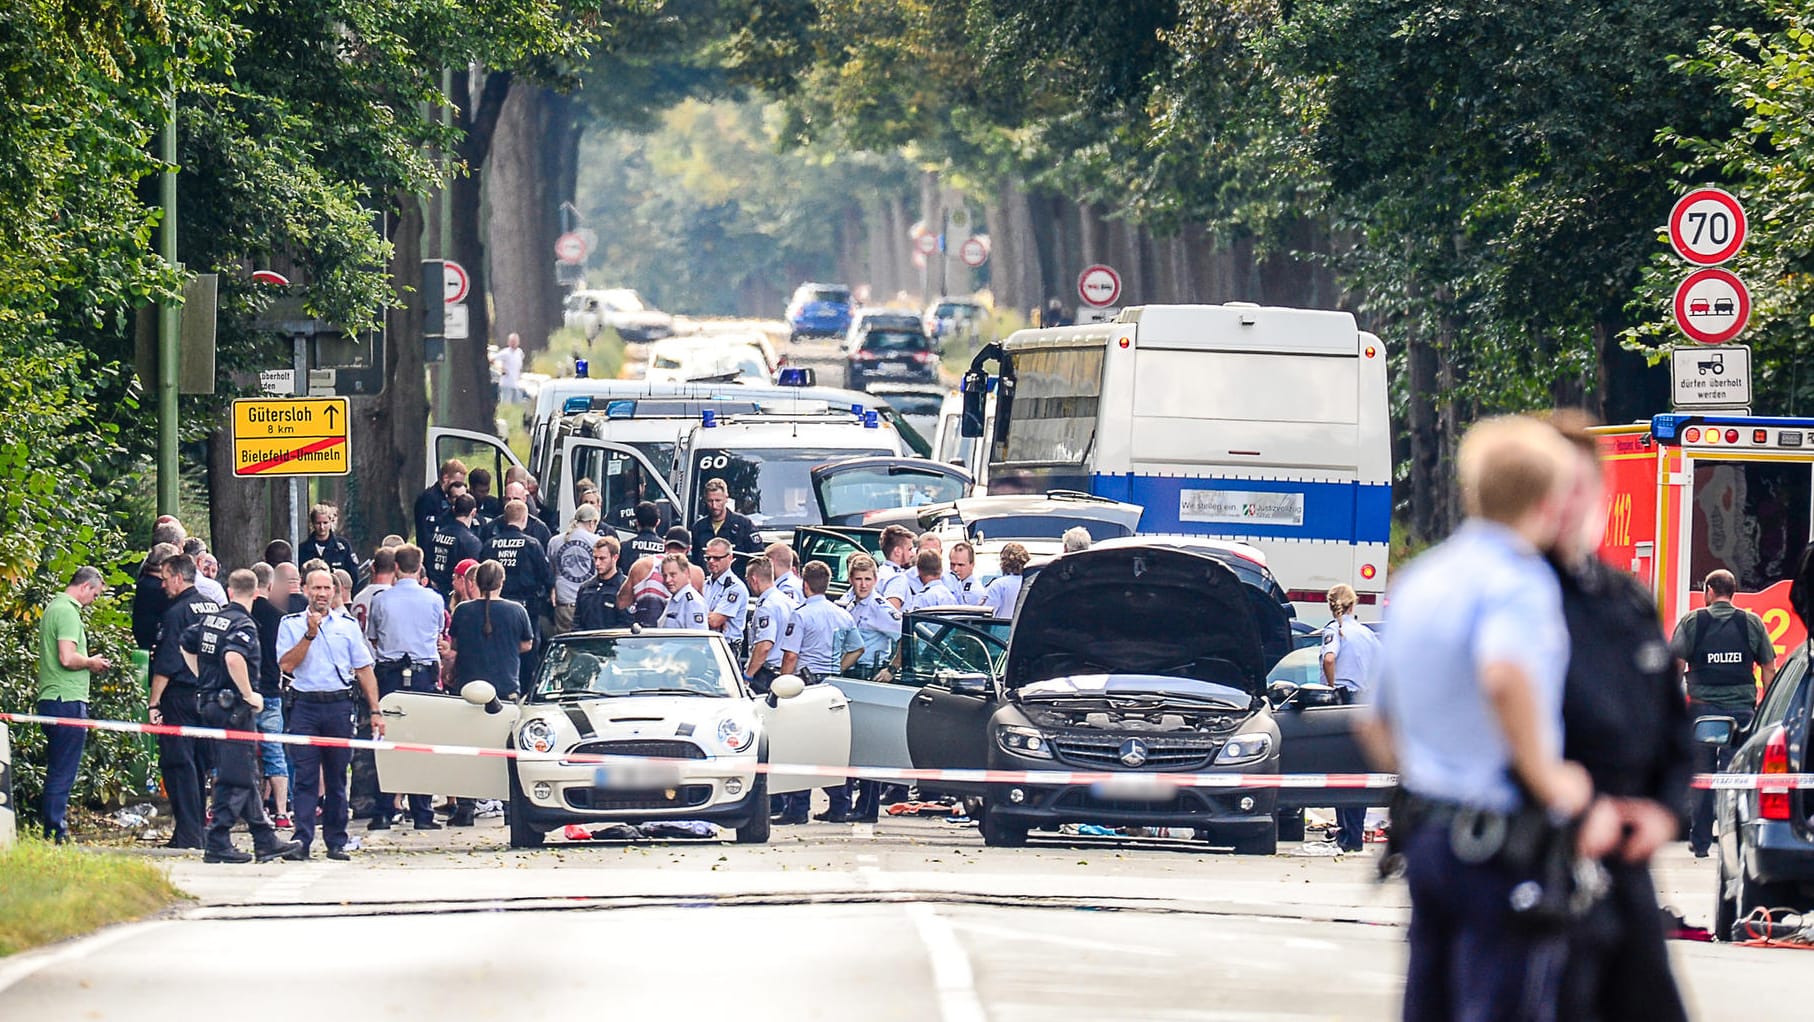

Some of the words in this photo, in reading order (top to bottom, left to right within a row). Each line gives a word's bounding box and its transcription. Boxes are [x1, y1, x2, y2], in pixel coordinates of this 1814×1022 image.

[1688, 212, 1729, 245] 70
[1681, 378, 1706, 388] dürfen
[1709, 378, 1742, 388] überholt
[1697, 390, 1727, 398] werden
[248, 406, 312, 422] Gütersloh
[268, 425, 274, 433] 8
[278, 425, 294, 433] km
[241, 449, 340, 463] Bielefeld-Ummeln
[700, 456, 728, 469] 60
[620, 508, 636, 518] POL
[1614, 493, 1631, 546] 112
[492, 538, 525, 548] POLIZEI
[498, 550, 517, 558] NRW
[1707, 652, 1742, 663] POLIZEI
